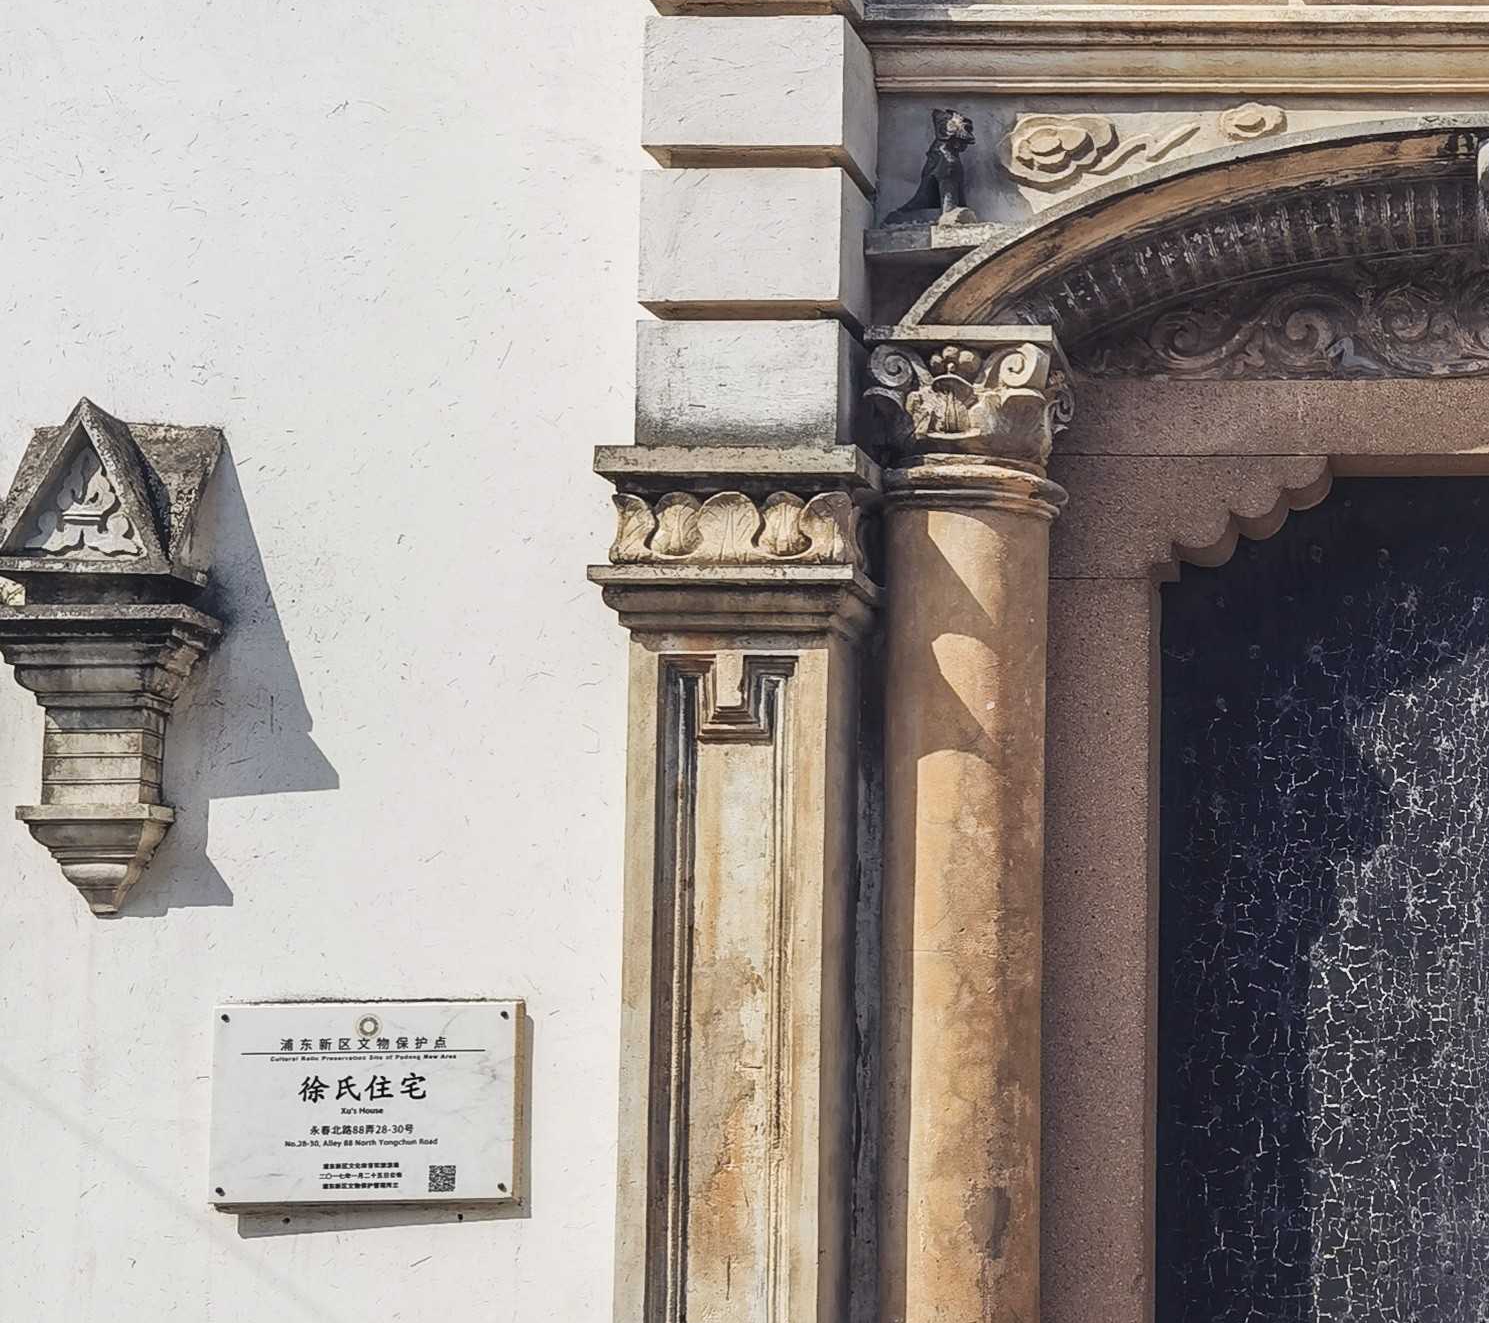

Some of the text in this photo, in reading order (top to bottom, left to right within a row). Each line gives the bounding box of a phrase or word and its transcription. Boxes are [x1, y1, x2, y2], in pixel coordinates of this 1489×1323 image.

[280, 1036, 447, 1051] 浦东新区文物保护点
[298, 1072, 427, 1103] 徐氏住宅
[341, 1107, 383, 1115] Xu's House
[323, 1139, 342, 1149] Alley
[355, 1139, 376, 1147] North
[419, 1137, 438, 1146] Road
